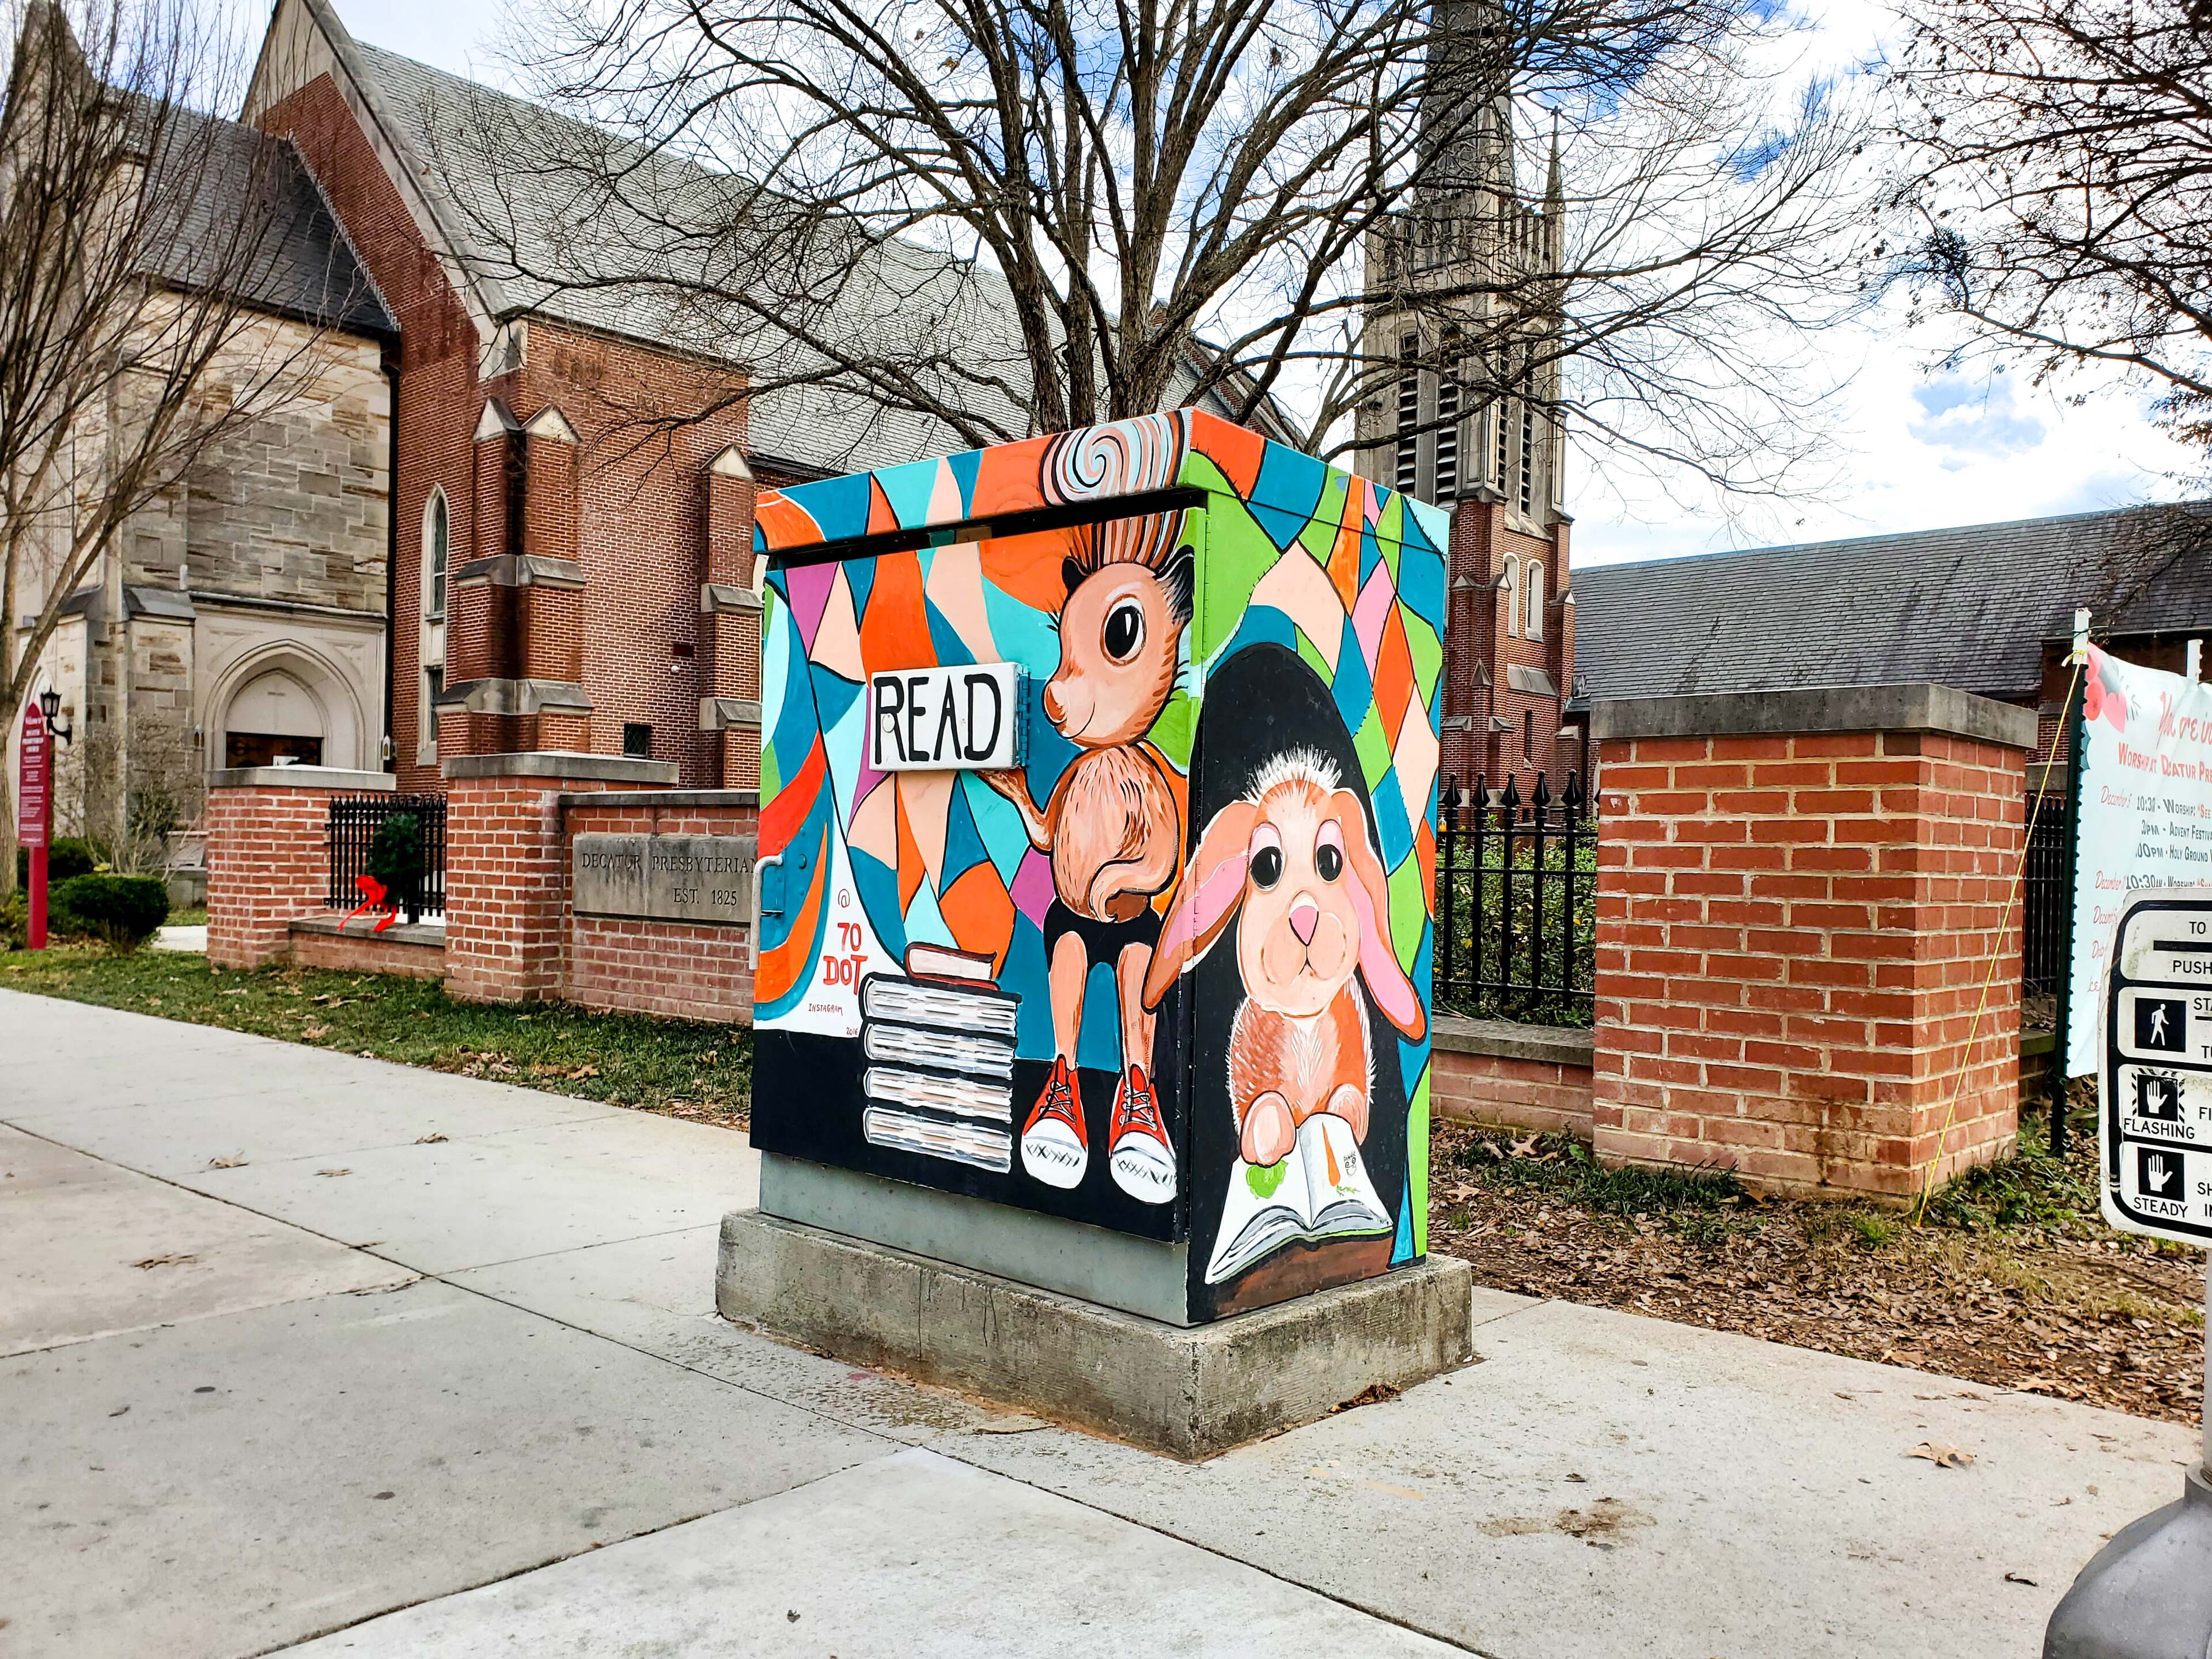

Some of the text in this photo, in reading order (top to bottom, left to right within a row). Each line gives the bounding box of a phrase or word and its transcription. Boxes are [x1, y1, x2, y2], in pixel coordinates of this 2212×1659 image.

[873, 673, 1001, 764] READ
[2161, 754, 2196, 780] DCATUR
[2169, 821, 2190, 838] ADVENT
[582, 853, 641, 869] DECATUR
[2169, 844, 2183, 859] HOLY
[2184, 846, 2208, 862] GROUND
[673, 888, 737, 906] EST. 1825
[838, 889, 850, 908] @
[838, 922, 862, 951] 70
[2188, 922, 2206, 934] TO
[823, 955, 868, 995] DOT
[2173, 960, 2212, 975] PUSH
[808, 1003, 843, 1016] INSTAGRAM
[2193, 997, 2212, 1011] ST
[846, 1027, 858, 1035] 2016
[2124, 1118, 2195, 1139] FLASHING
[2134, 1196, 2188, 1218] STEADY
